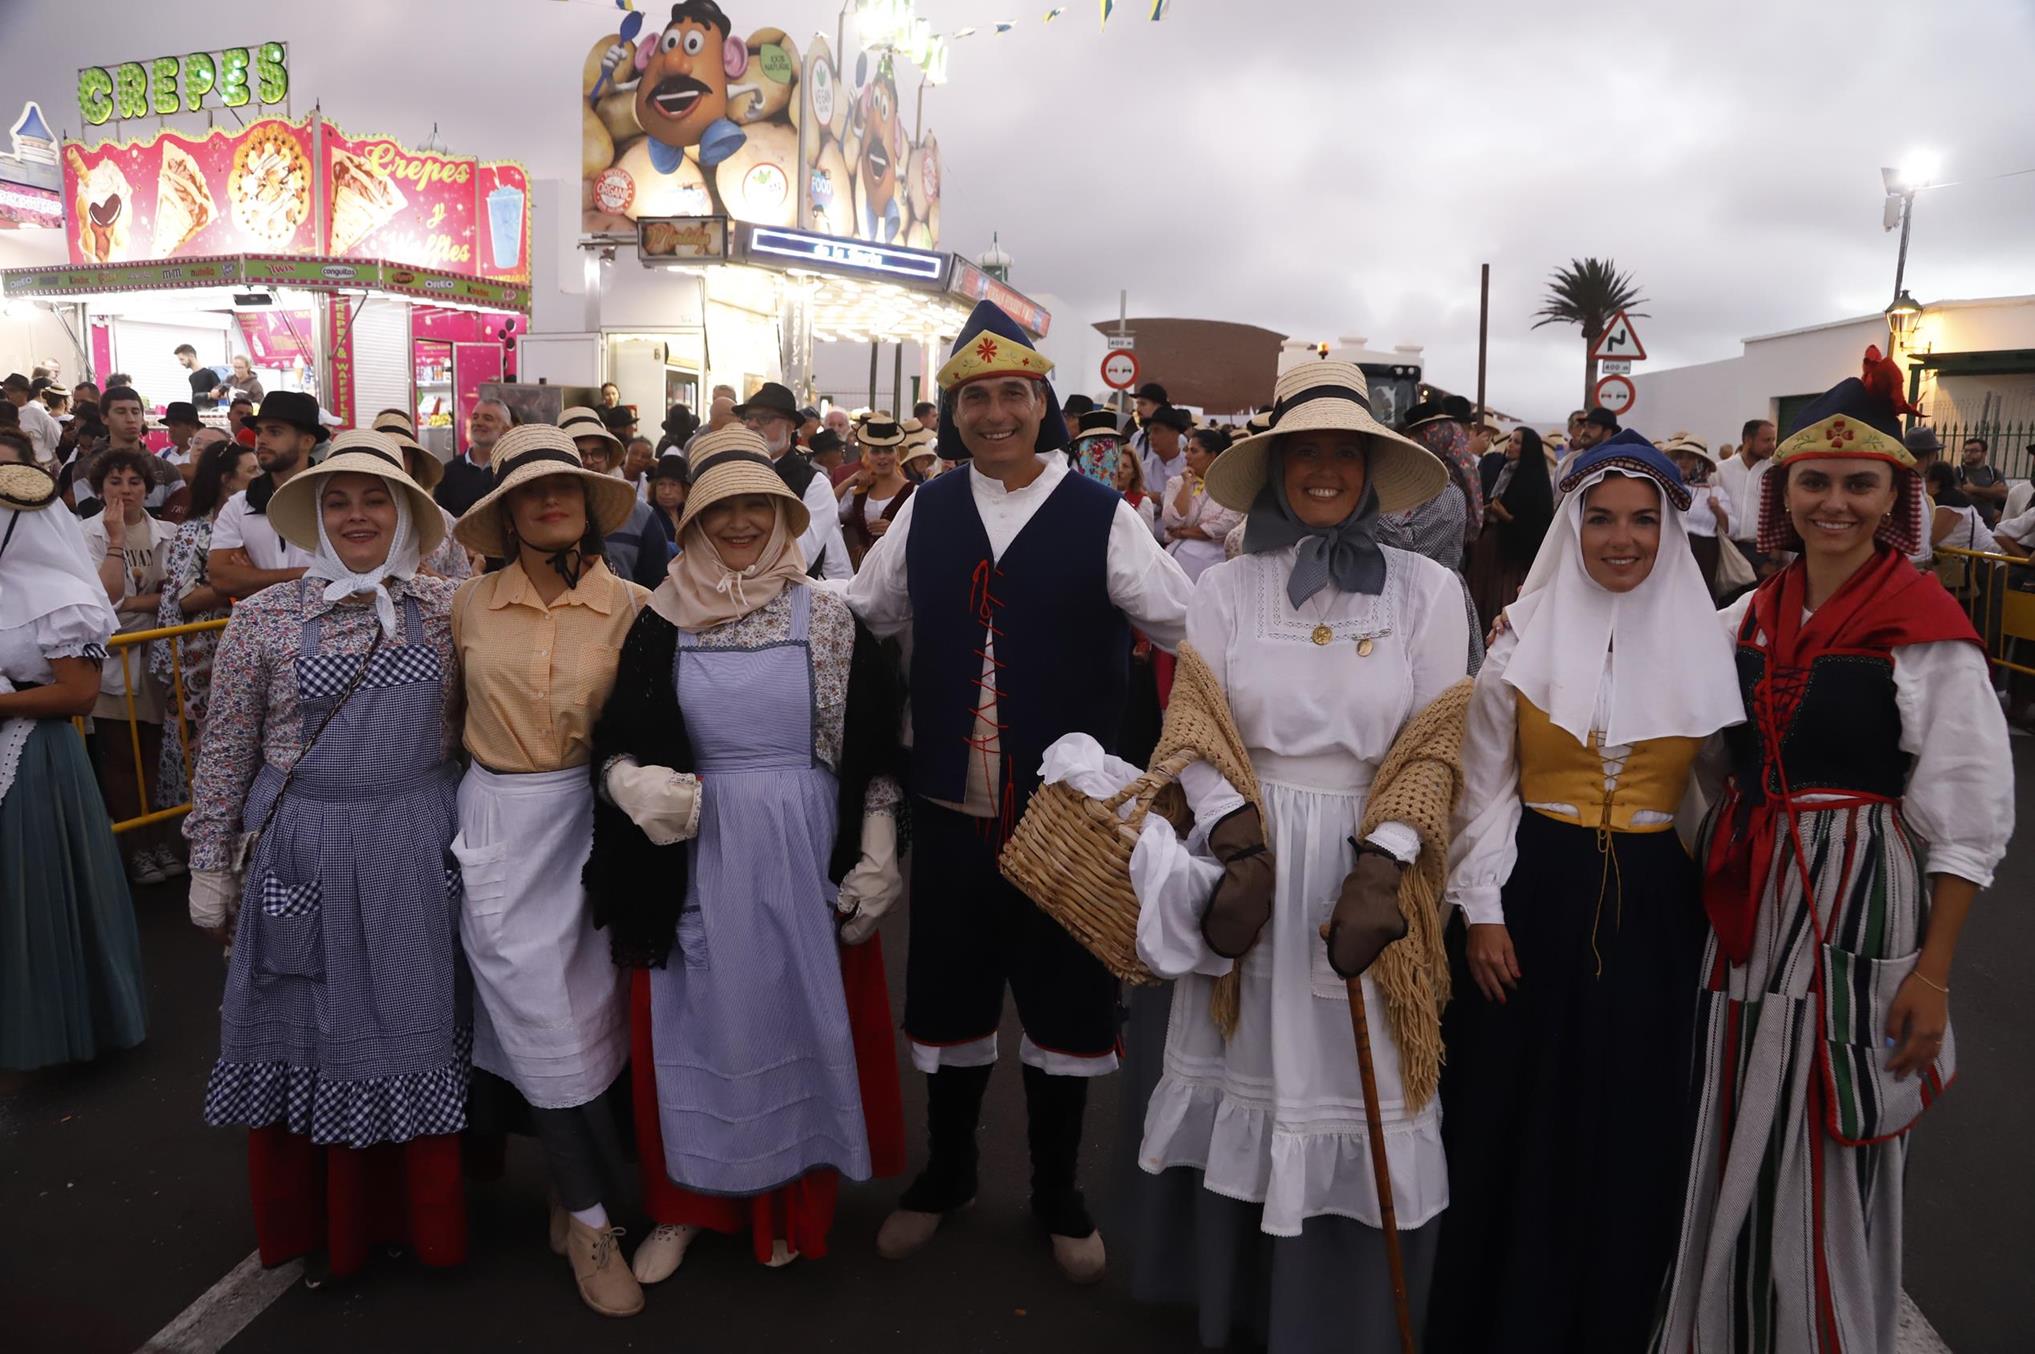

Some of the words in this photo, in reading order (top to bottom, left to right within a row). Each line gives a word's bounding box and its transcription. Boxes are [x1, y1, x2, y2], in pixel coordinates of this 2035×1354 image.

[78, 42, 289, 126] CREPES
[365, 144, 470, 191] Crepes
[426, 203, 446, 229] y
[425, 280, 454, 289] OREO
